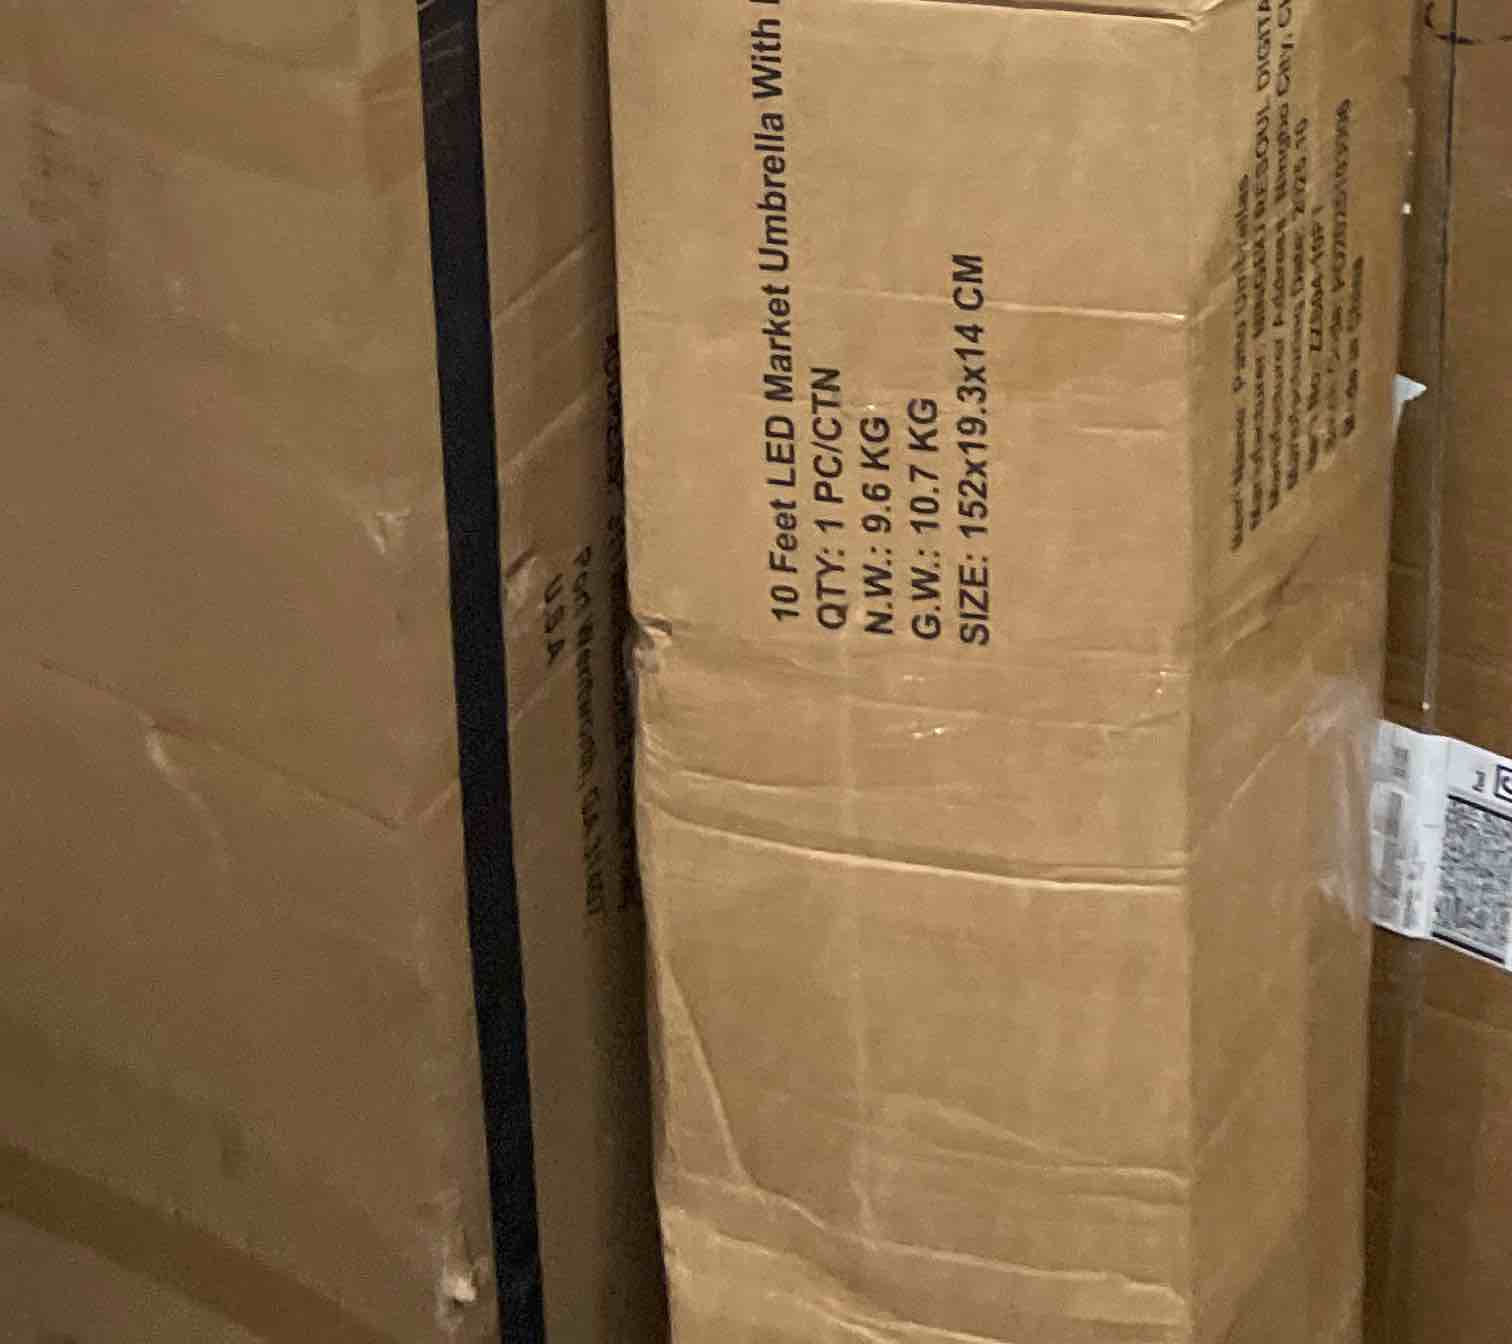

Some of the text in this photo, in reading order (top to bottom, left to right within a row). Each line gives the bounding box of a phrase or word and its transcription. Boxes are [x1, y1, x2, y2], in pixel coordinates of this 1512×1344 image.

[749, 18, 783, 100] With
[753, 112, 790, 273] Umbrella
[762, 284, 792, 403] Market
[764, 414, 796, 489] LED
[860, 415, 891, 471] KG
[907, 398, 939, 453] KG
[951, 253, 990, 646] SIZE: 152x19.3x14 CM
[810, 367, 849, 631] QTY: 1 PC/CTN
[861, 484, 893, 534] 9.6
[909, 464, 941, 535] 10.7
[766, 499, 799, 576] Feet
[770, 584, 800, 624] 10
